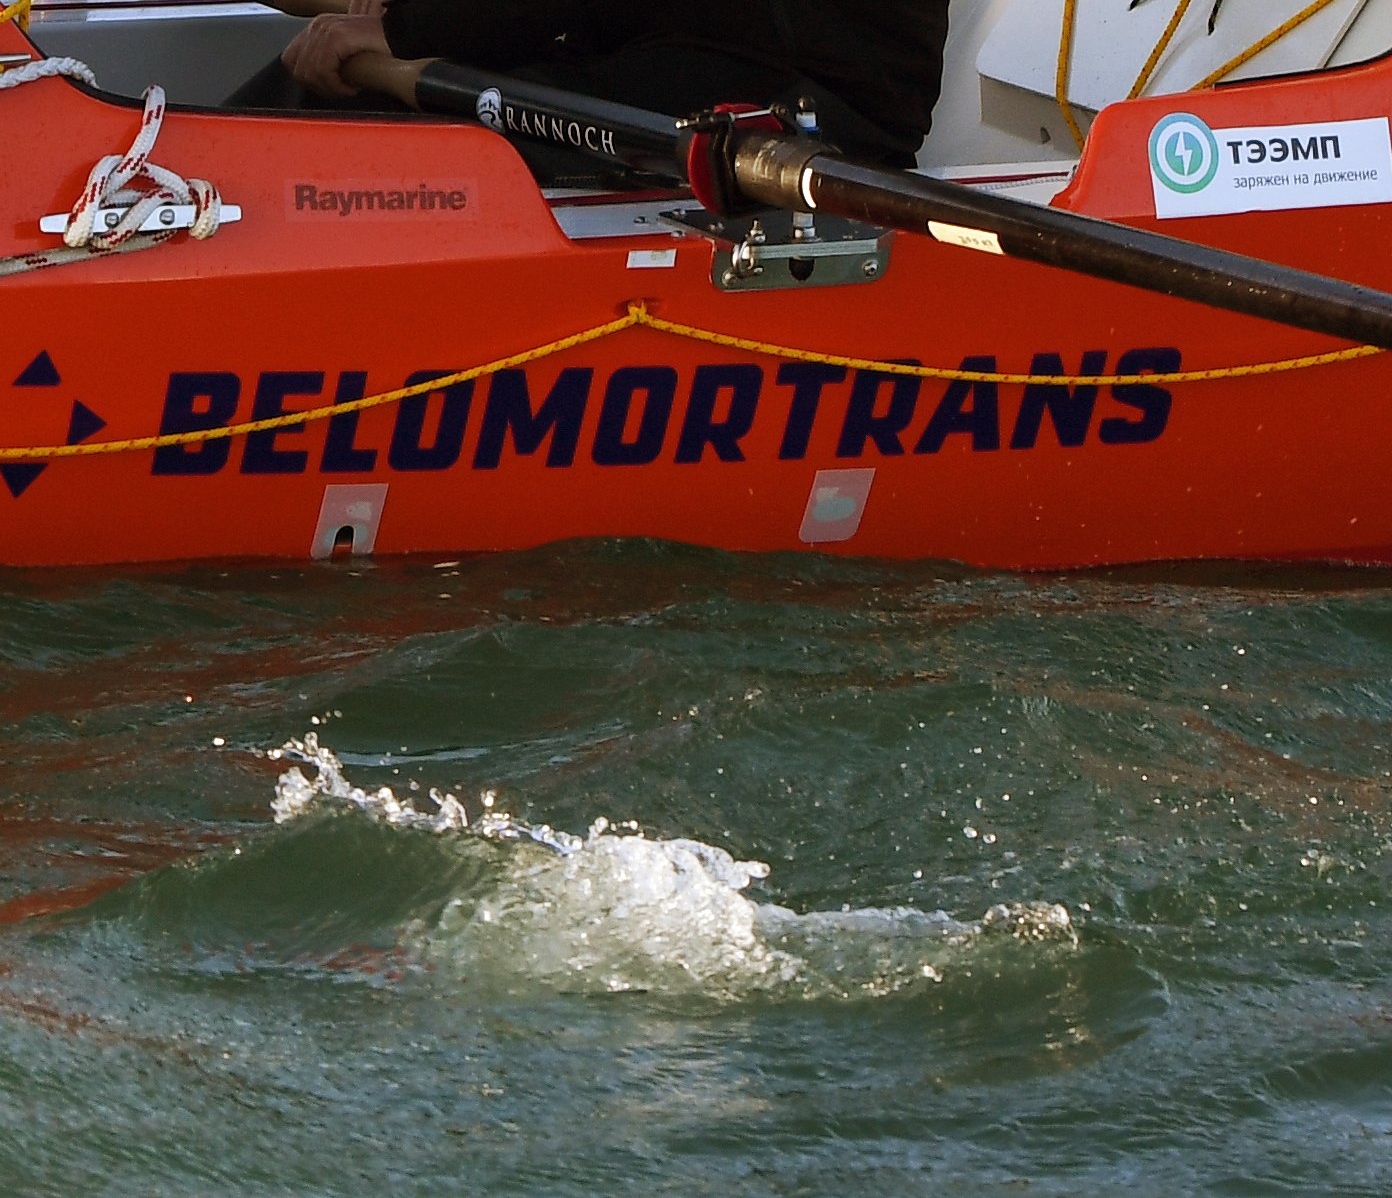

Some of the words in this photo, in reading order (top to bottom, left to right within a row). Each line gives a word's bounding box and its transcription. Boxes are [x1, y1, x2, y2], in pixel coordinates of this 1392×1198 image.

[506, 106, 616, 155] RANNOCH
[1226, 135, 1342, 165] ТЭЭМП
[1233, 174, 1290, 190] заряжен
[1294, 173, 1309, 185] на
[1313, 168, 1378, 186] движение
[295, 183, 468, 217] Raymarine
[151, 347, 1182, 476] BELOMORTRANS
